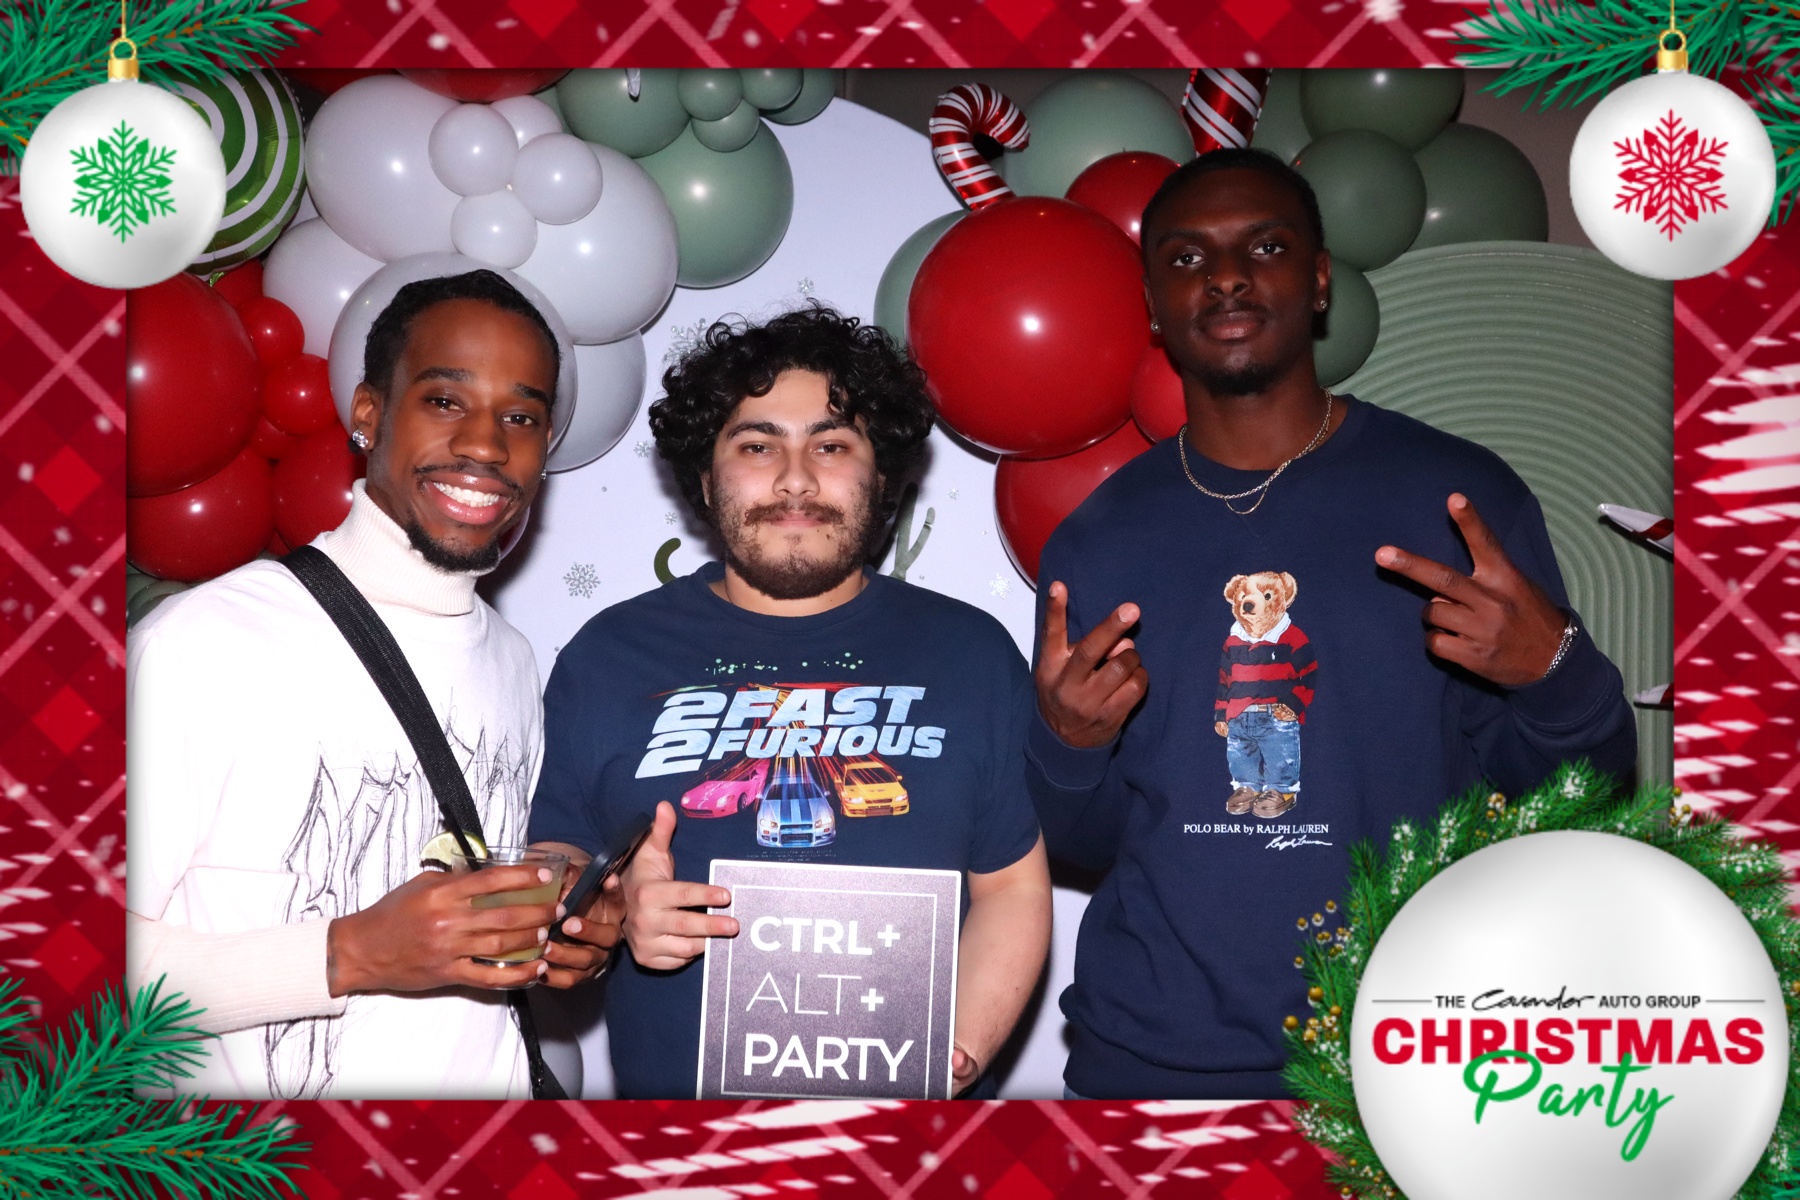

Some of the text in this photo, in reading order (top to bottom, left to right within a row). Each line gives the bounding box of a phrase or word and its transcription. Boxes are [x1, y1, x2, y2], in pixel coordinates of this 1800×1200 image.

[1183, 824, 1329, 835] POLO BEAR by RALPH LAUREN
[743, 1033, 914, 1082] PARTY
